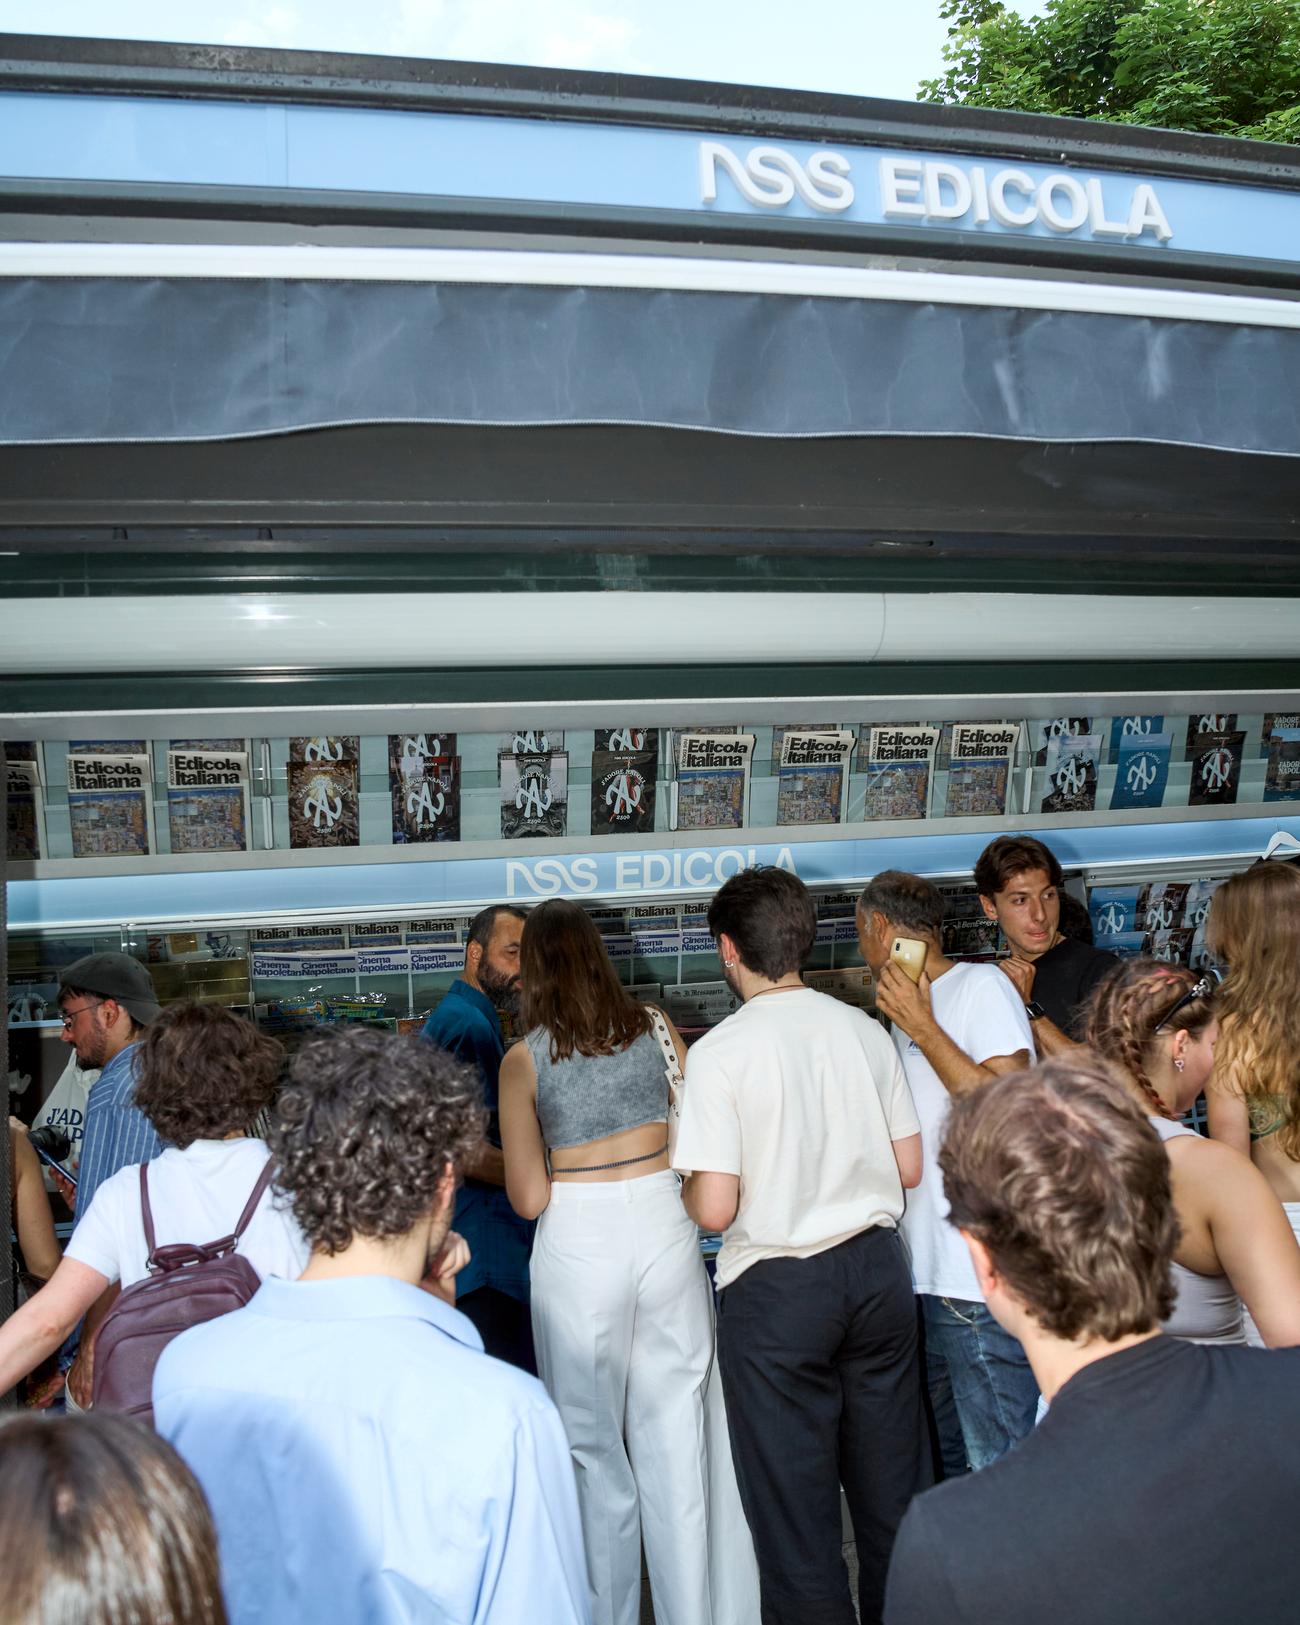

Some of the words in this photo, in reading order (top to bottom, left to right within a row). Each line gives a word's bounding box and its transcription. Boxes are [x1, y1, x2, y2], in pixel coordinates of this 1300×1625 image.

[878, 156, 1174, 243] EDICOLA
[878, 732, 934, 746] Edicola
[960, 729, 1014, 743] Edicola
[688, 739, 748, 753] Edicola
[790, 737, 848, 751] Edicola
[958, 743, 1008, 757] Italiana
[686, 753, 742, 767] Italiana
[787, 751, 841, 764] Italiana
[876, 746, 928, 760] Italiana
[74, 760, 142, 775] Edicola
[174, 755, 242, 771] Edicola
[75, 774, 141, 789] Italiana
[175, 771, 240, 785] Italiana
[634, 906, 676, 917] Italiana
[684, 904, 709, 915] Italia
[297, 926, 342, 937] Italiana
[355, 924, 399, 935] Italiana
[410, 921, 454, 932] Italiana
[253, 961, 290, 969] Cinema
[411, 954, 446, 963] Cinema
[301, 962, 338, 970] Cinema
[301, 967, 356, 977] Napoletano
[411, 961, 464, 971] Napoletano
[46, 1107, 83, 1126] J'AD
